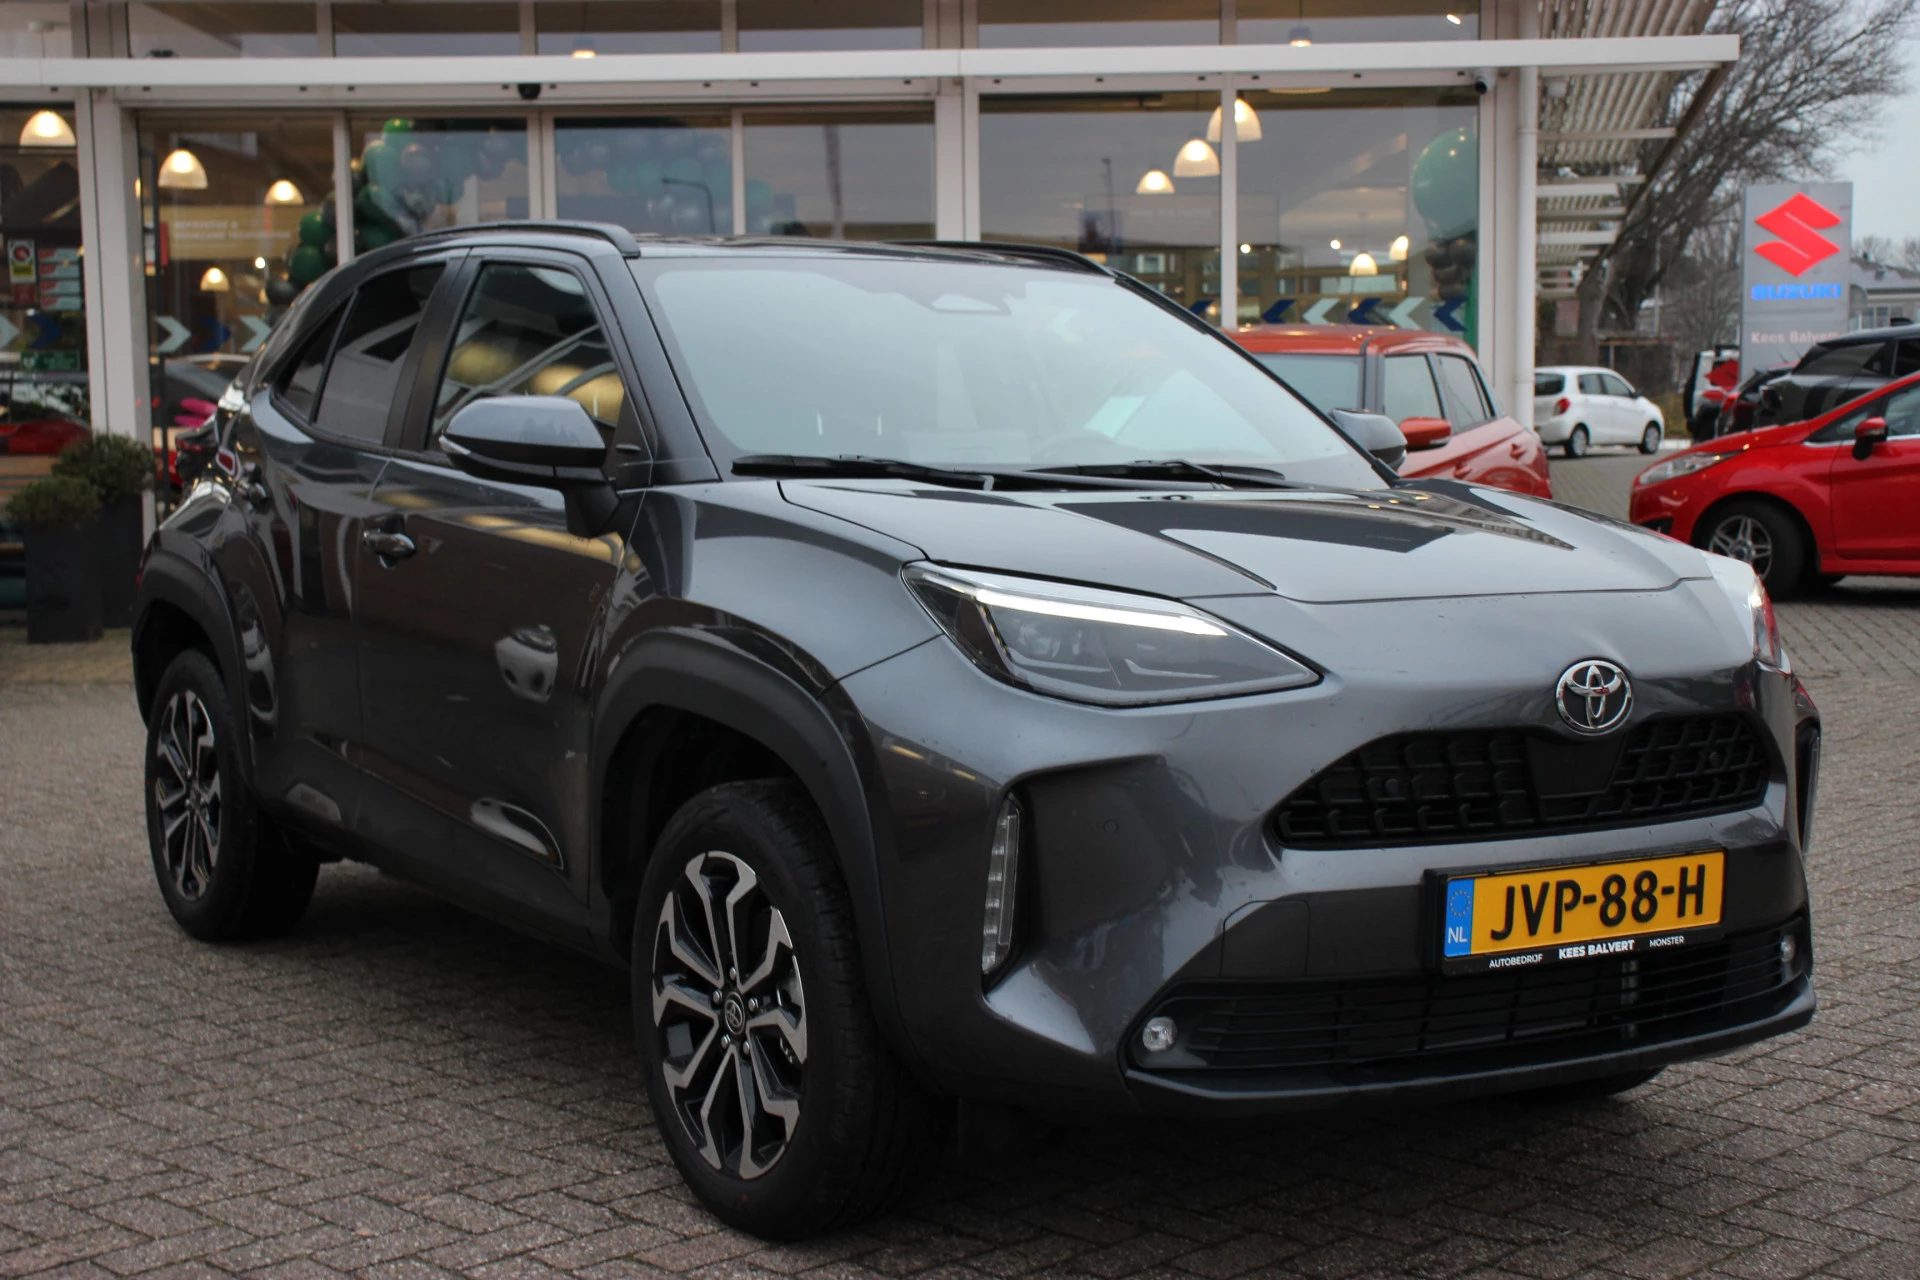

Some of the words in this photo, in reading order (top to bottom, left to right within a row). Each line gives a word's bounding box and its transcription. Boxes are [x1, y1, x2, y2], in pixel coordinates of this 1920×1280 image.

[1751, 283, 1842, 300] SUZUKI
[1751, 331, 1786, 345] Kees
[1490, 863, 1706, 941] JVP-88-H
[1448, 926, 1468, 944] NL
[1489, 953, 1544, 969] AUTOBEDRIJF
[1558, 946, 1586, 960] KEES
[1588, 939, 1635, 957] BALVERT
[1649, 935, 1685, 948] MONSTER
